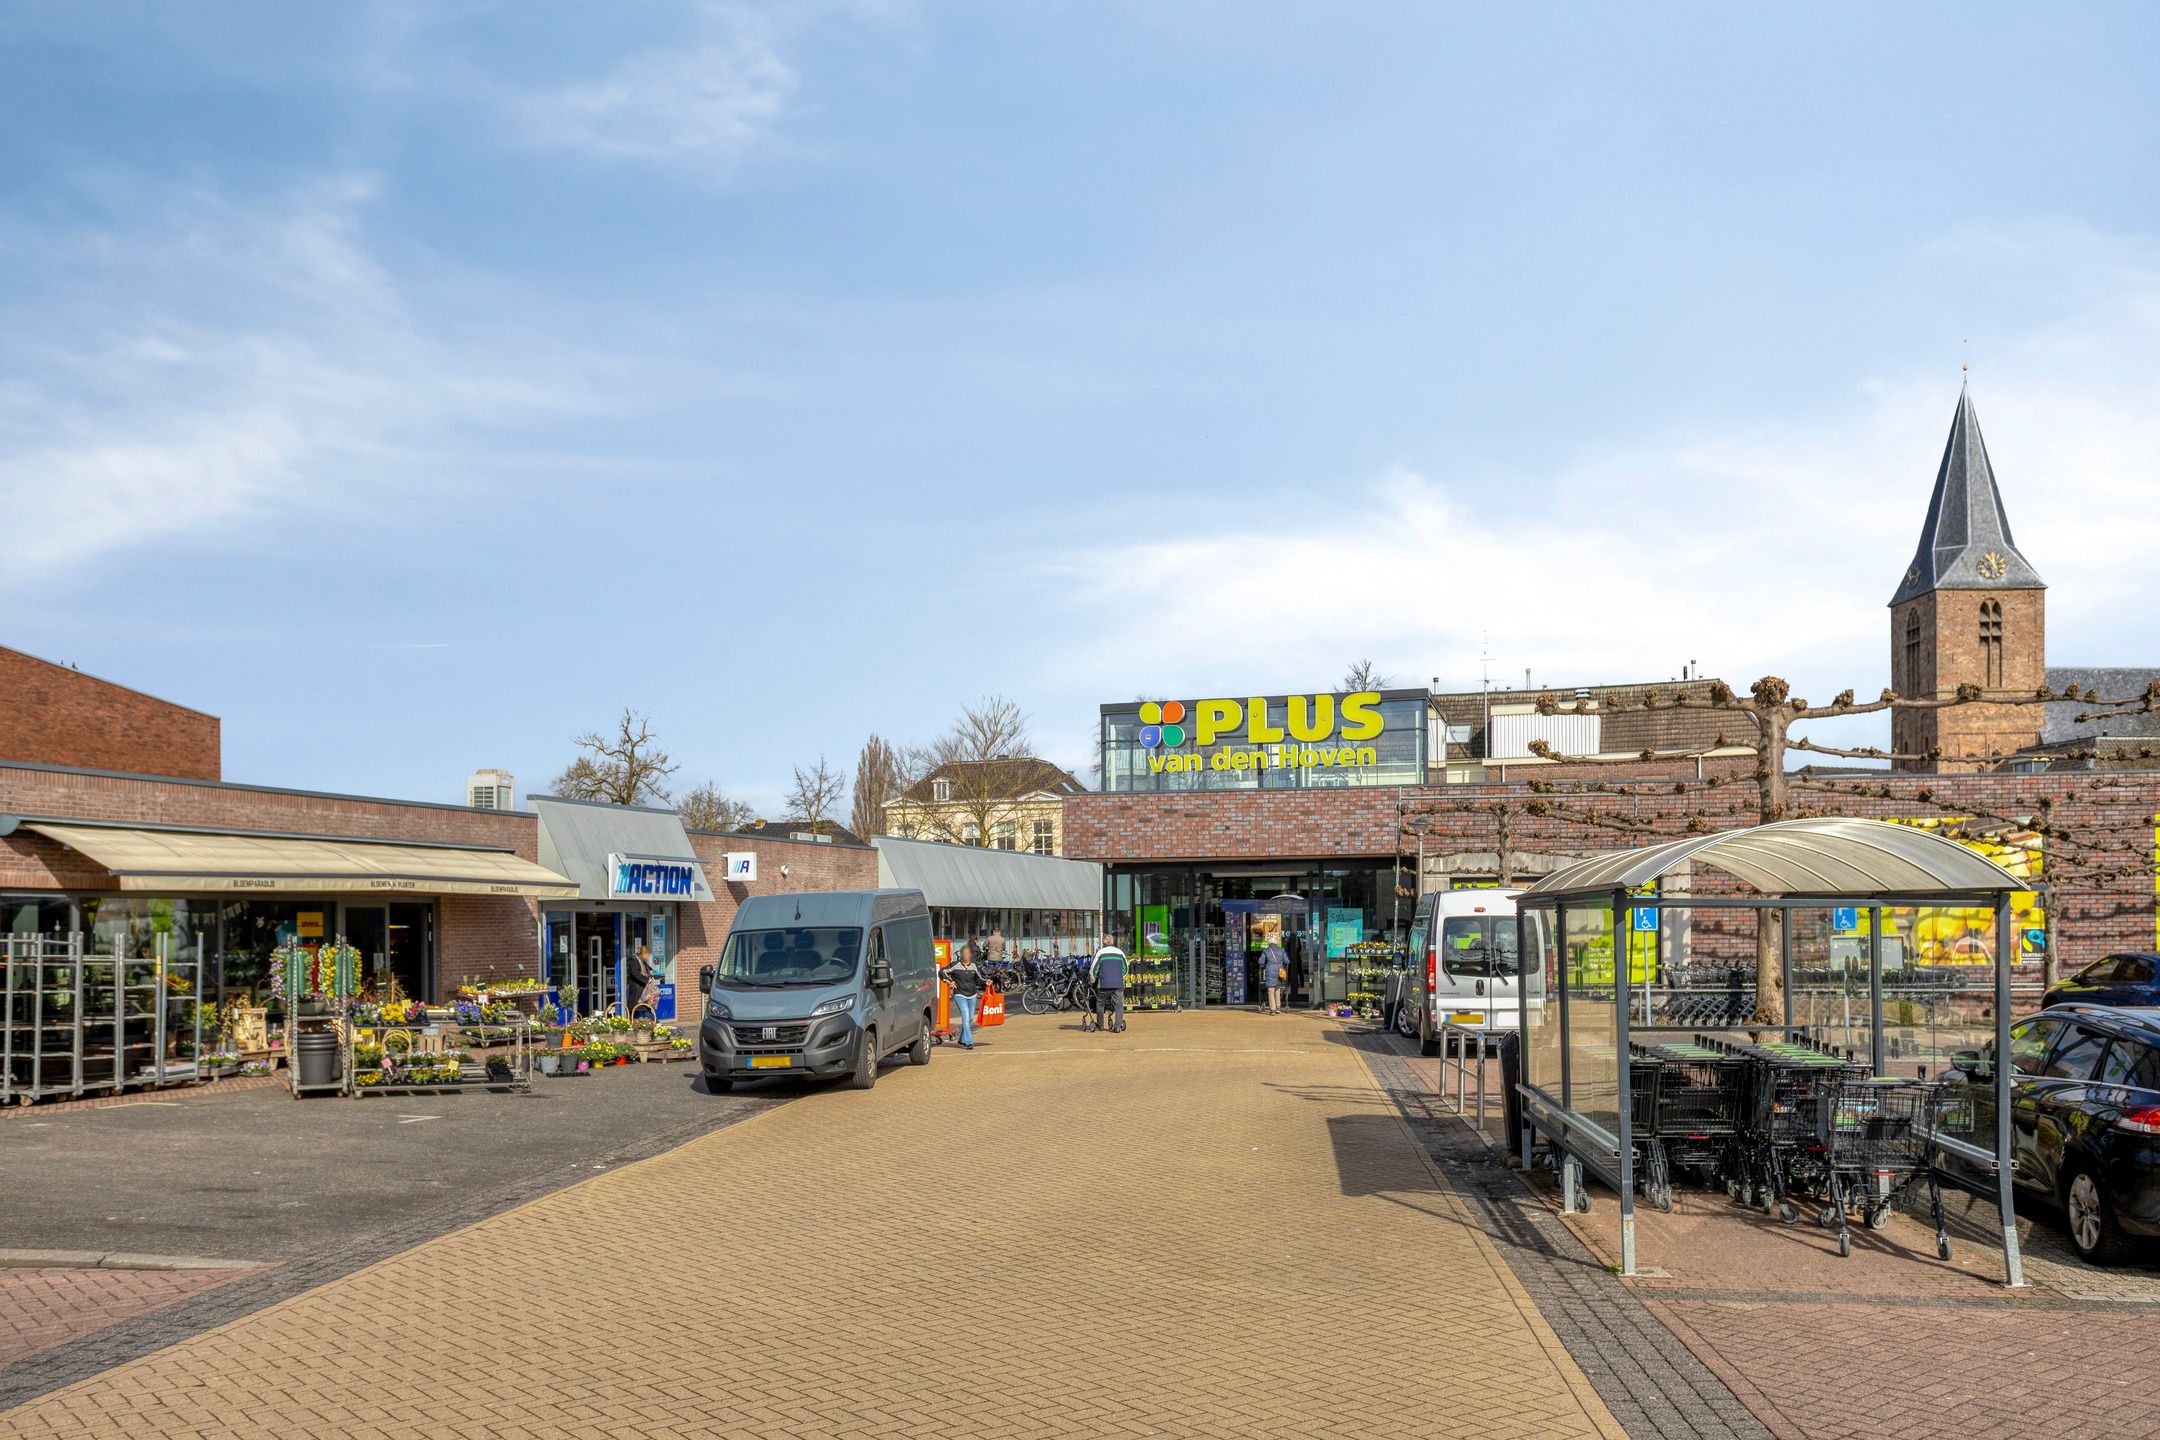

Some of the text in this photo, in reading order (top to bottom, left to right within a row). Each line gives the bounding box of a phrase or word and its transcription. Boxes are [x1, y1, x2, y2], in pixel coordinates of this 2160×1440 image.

[1196, 691, 1385, 746] PLUS
[1147, 745, 1377, 773] van den Hoven
[626, 863, 693, 895] ACTION
[982, 1003, 1003, 1015] Boni
[762, 1027, 778, 1040] FIAT
